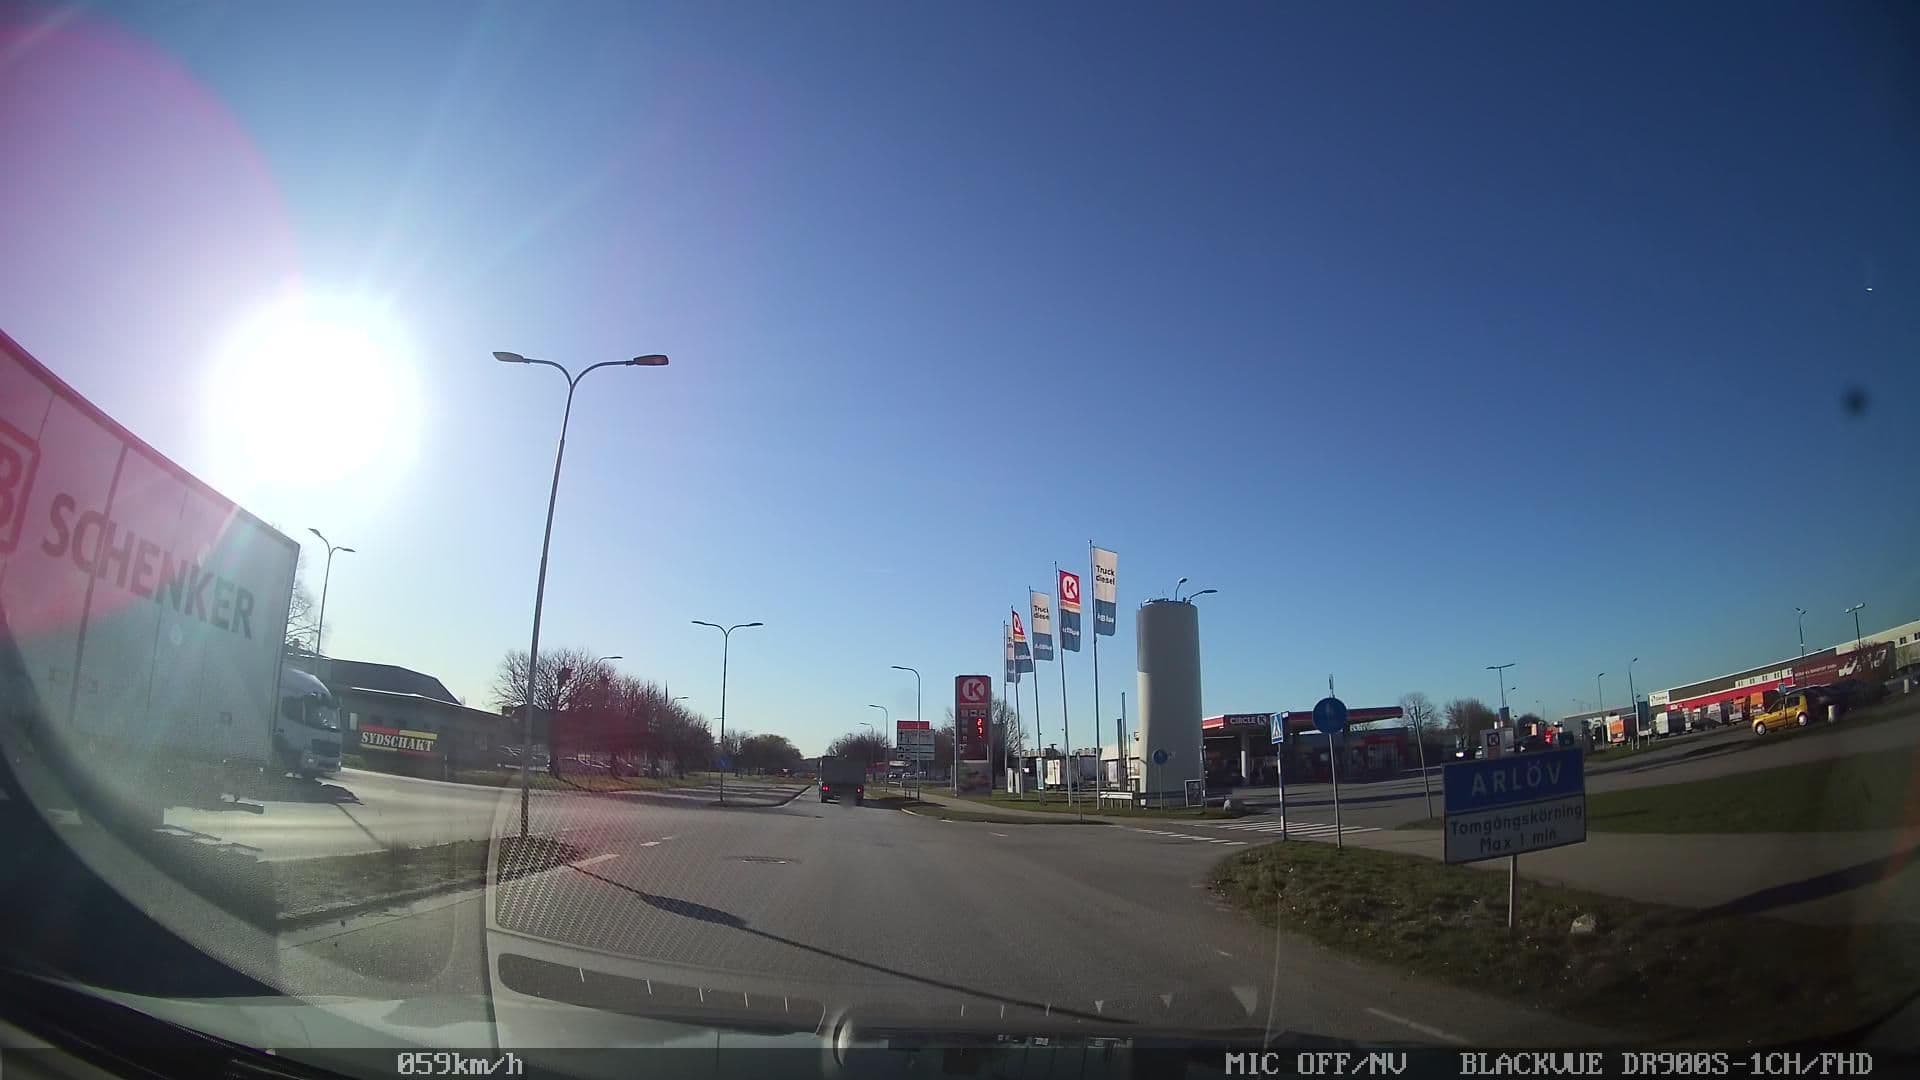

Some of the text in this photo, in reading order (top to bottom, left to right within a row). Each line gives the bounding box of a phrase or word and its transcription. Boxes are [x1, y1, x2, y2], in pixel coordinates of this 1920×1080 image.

[40, 492, 256, 640] SCHENKER
[1096, 565, 1115, 577] Truck
[1096, 574, 1116, 586] diesel
[1033, 612, 1050, 621] diese
[1229, 716, 1256, 725] CIRCLE
[360, 731, 434, 752] SYDSCHAKT
[1471, 759, 1562, 797] ARLÖV
[1451, 804, 1583, 837] Tomgångskörning
[1480, 829, 1558, 854] Max 1 min
